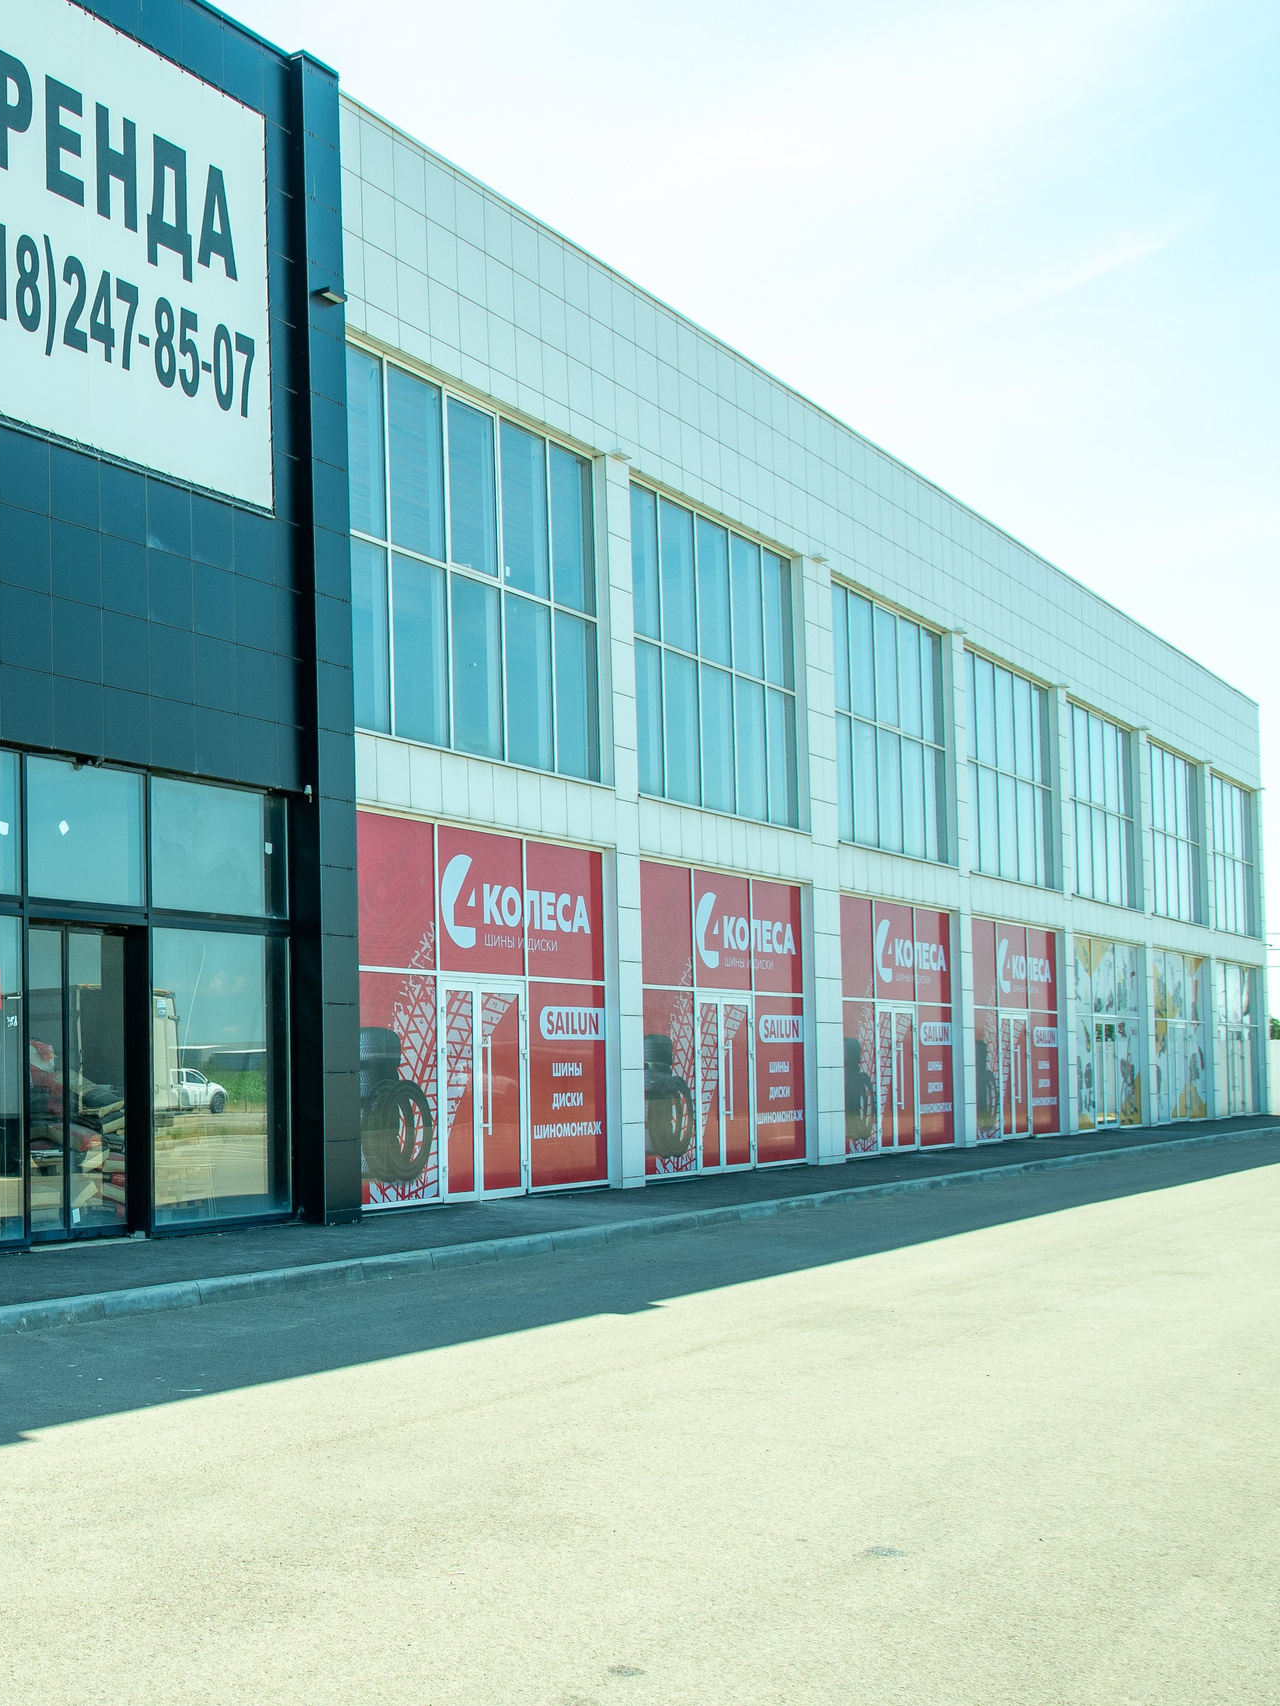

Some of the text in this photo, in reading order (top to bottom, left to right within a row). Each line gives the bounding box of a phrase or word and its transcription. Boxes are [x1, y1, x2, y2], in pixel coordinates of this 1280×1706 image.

[482, 883, 591, 934] КОЛЕСА
[484, 934, 514, 948] ШИНЫ
[527, 938, 558, 952] ДИСКИ
[724, 956, 745, 968] ШИНЫ
[546, 1011, 599, 1036] SAILUN
[764, 1018, 799, 1039] SAILUN
[924, 1026, 949, 1042] SAILUN
[552, 1062, 582, 1077] ШИНЫ
[768, 1060, 790, 1074] ШИНЫ
[552, 1092, 583, 1110] ДИСКИ
[768, 1086, 790, 1100] ДИСКИ
[534, 1121, 602, 1140] ШИНОМОНТАЖ
